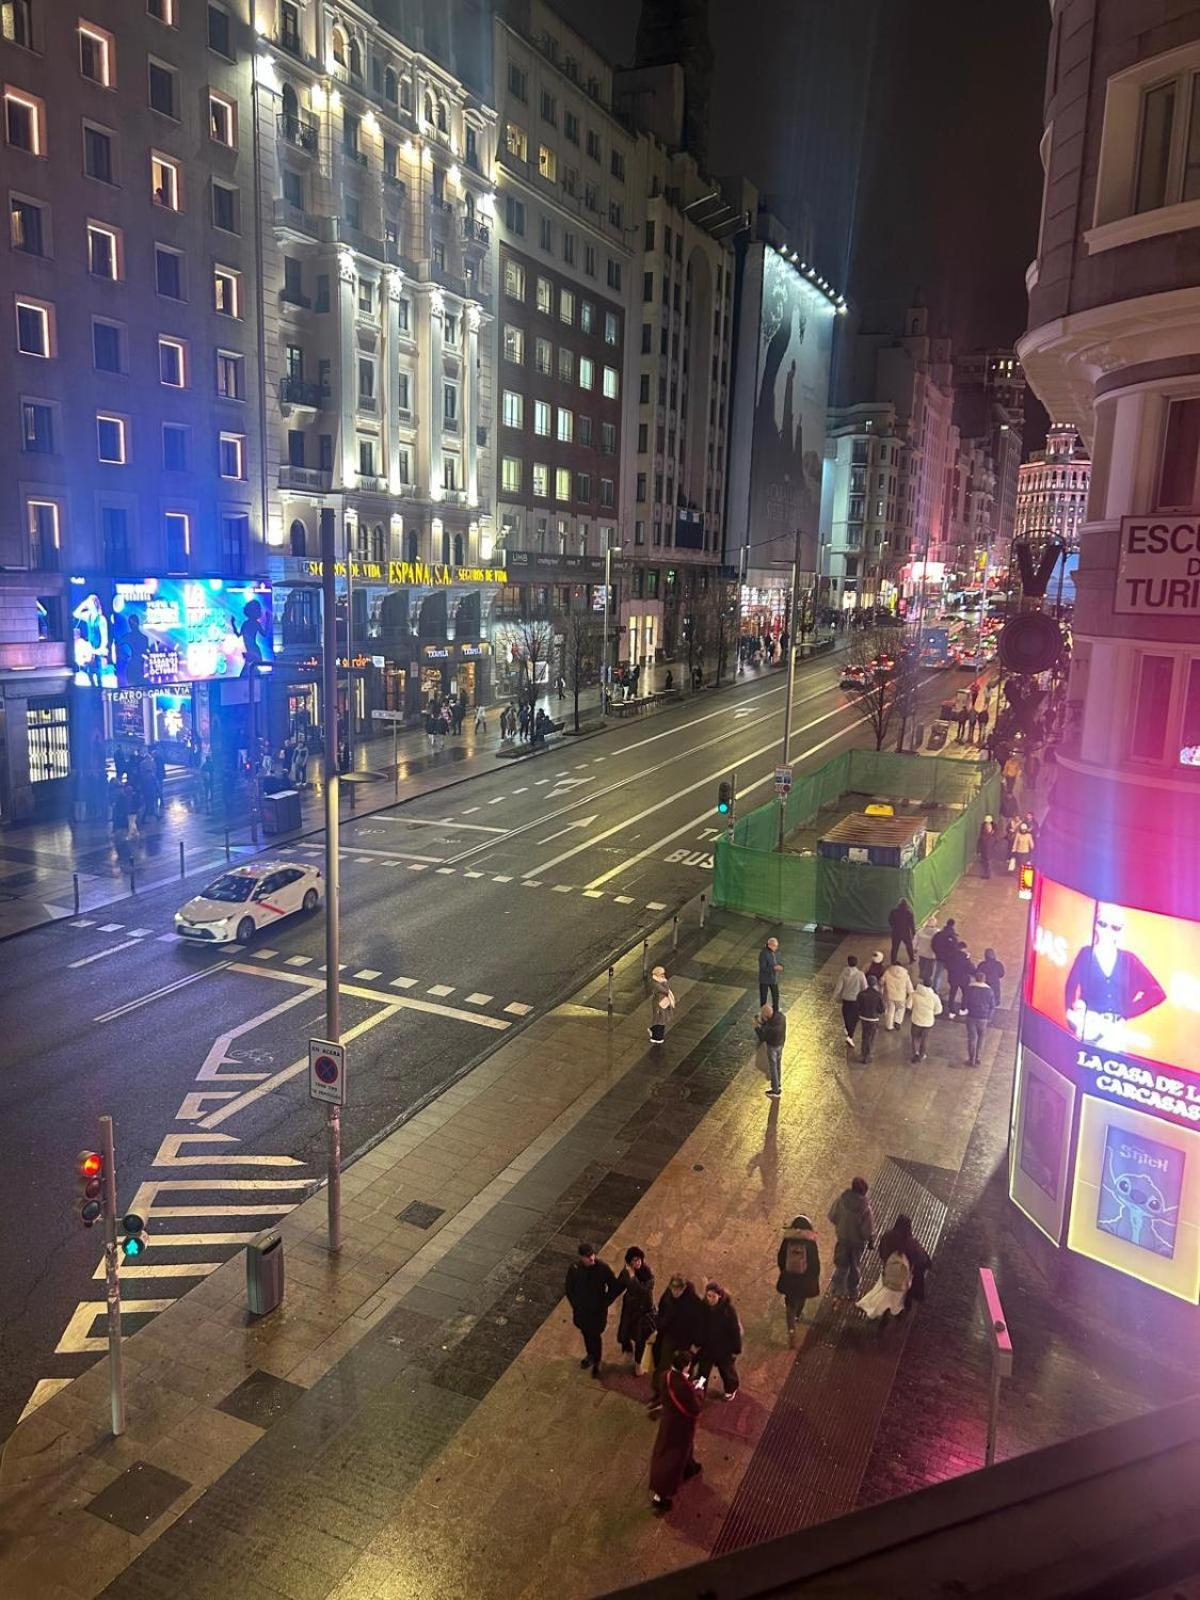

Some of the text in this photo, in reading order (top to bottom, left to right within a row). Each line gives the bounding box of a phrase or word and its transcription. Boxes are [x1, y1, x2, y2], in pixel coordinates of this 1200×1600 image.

[107, 690, 143, 702] TEATRO
[1077, 1051, 1104, 1072] LA
[1103, 1060, 1155, 1088] CASA
[1156, 1075, 1185, 1097] DE
